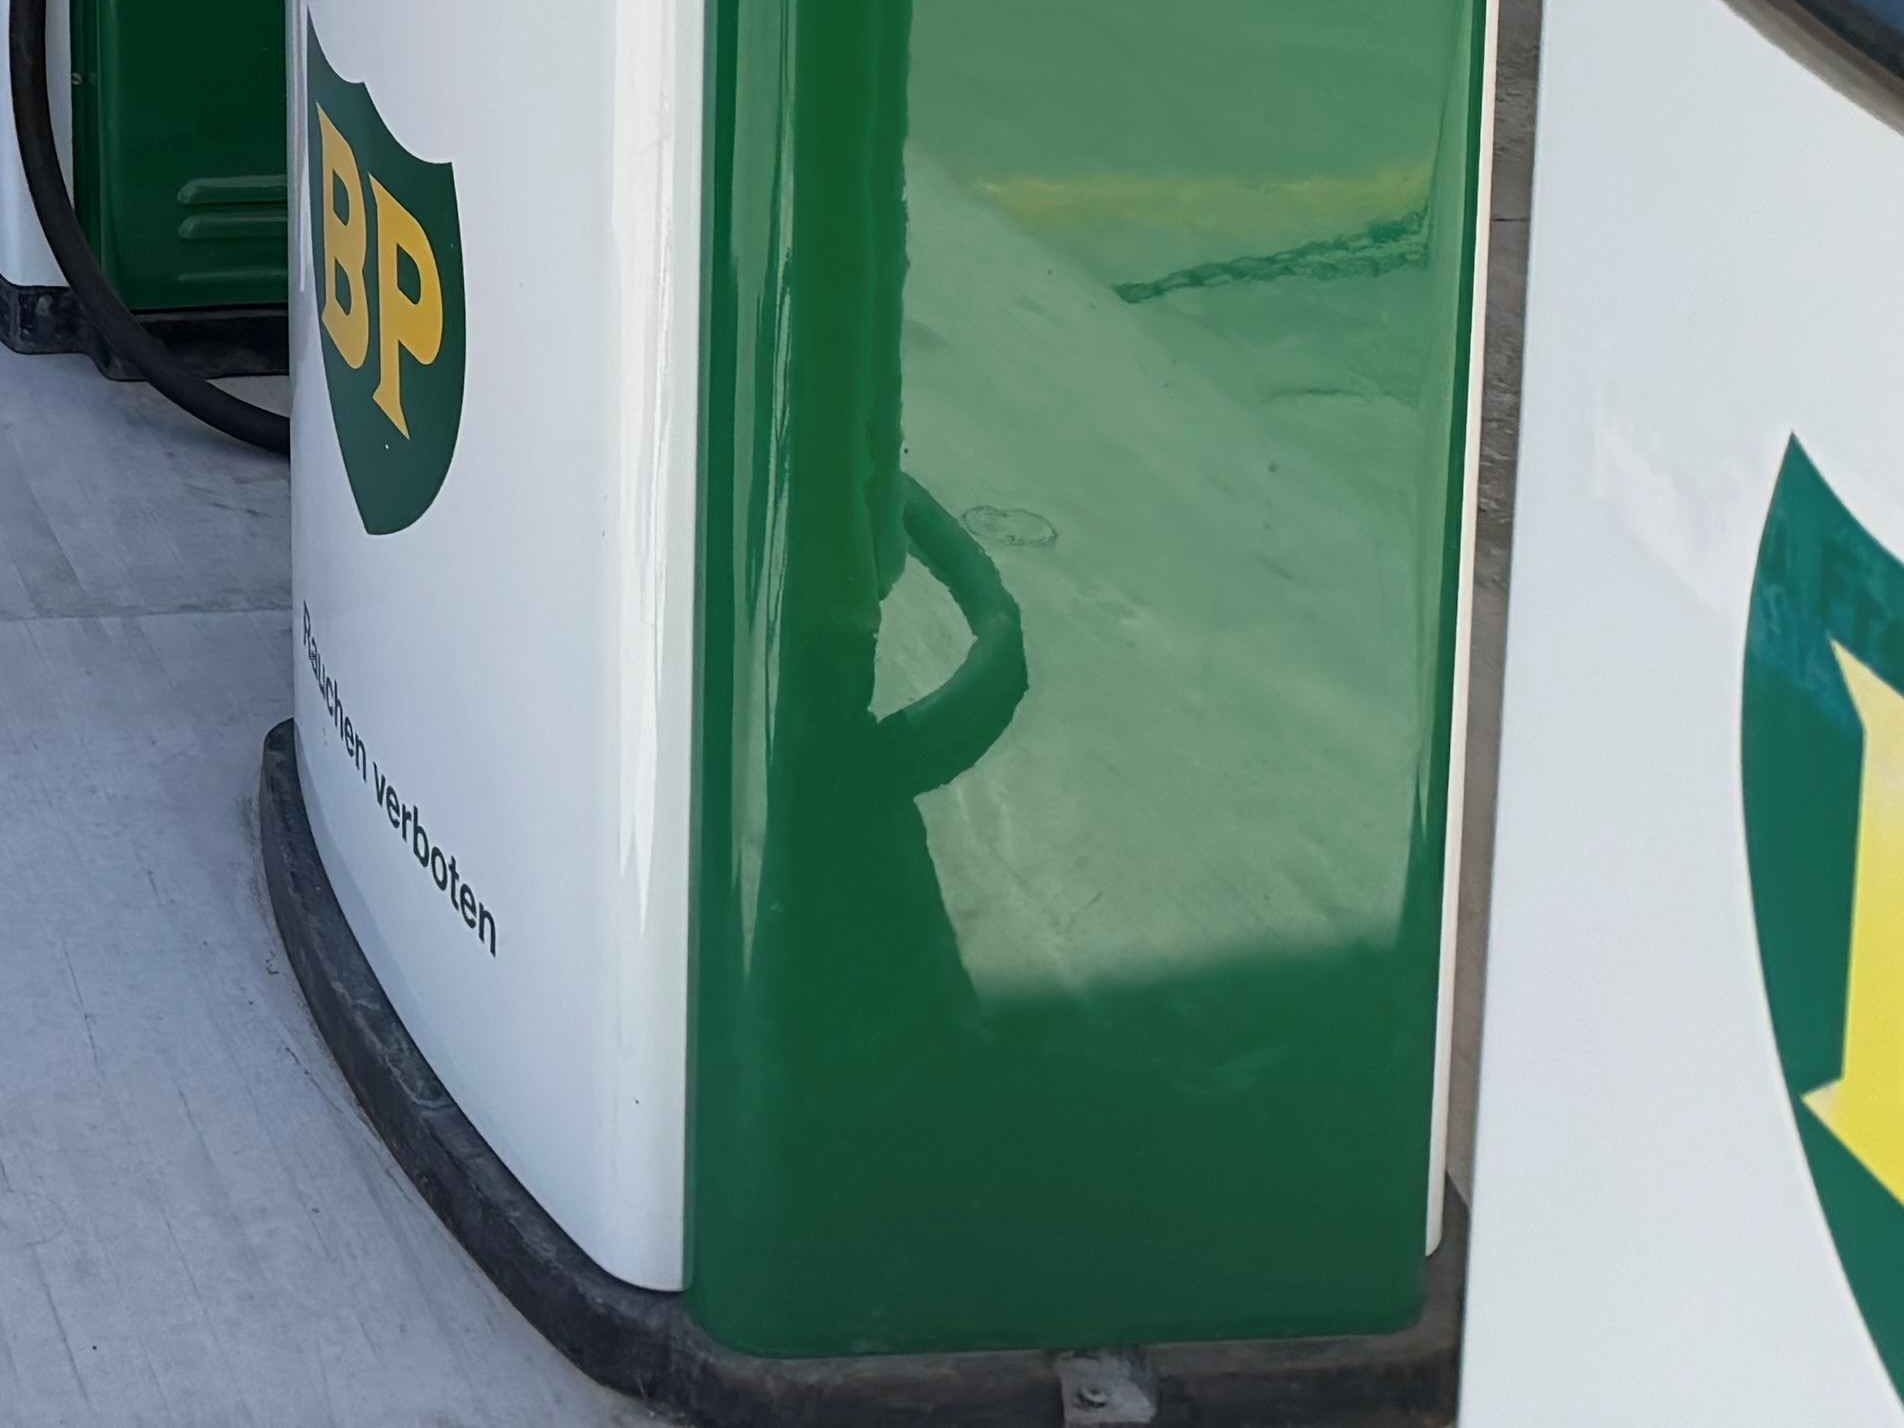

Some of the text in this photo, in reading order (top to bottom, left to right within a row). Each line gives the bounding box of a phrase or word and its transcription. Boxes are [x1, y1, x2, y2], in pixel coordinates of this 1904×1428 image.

[316, 100, 445, 441] BP
[302, 598, 497, 958] Rauchen verboten
